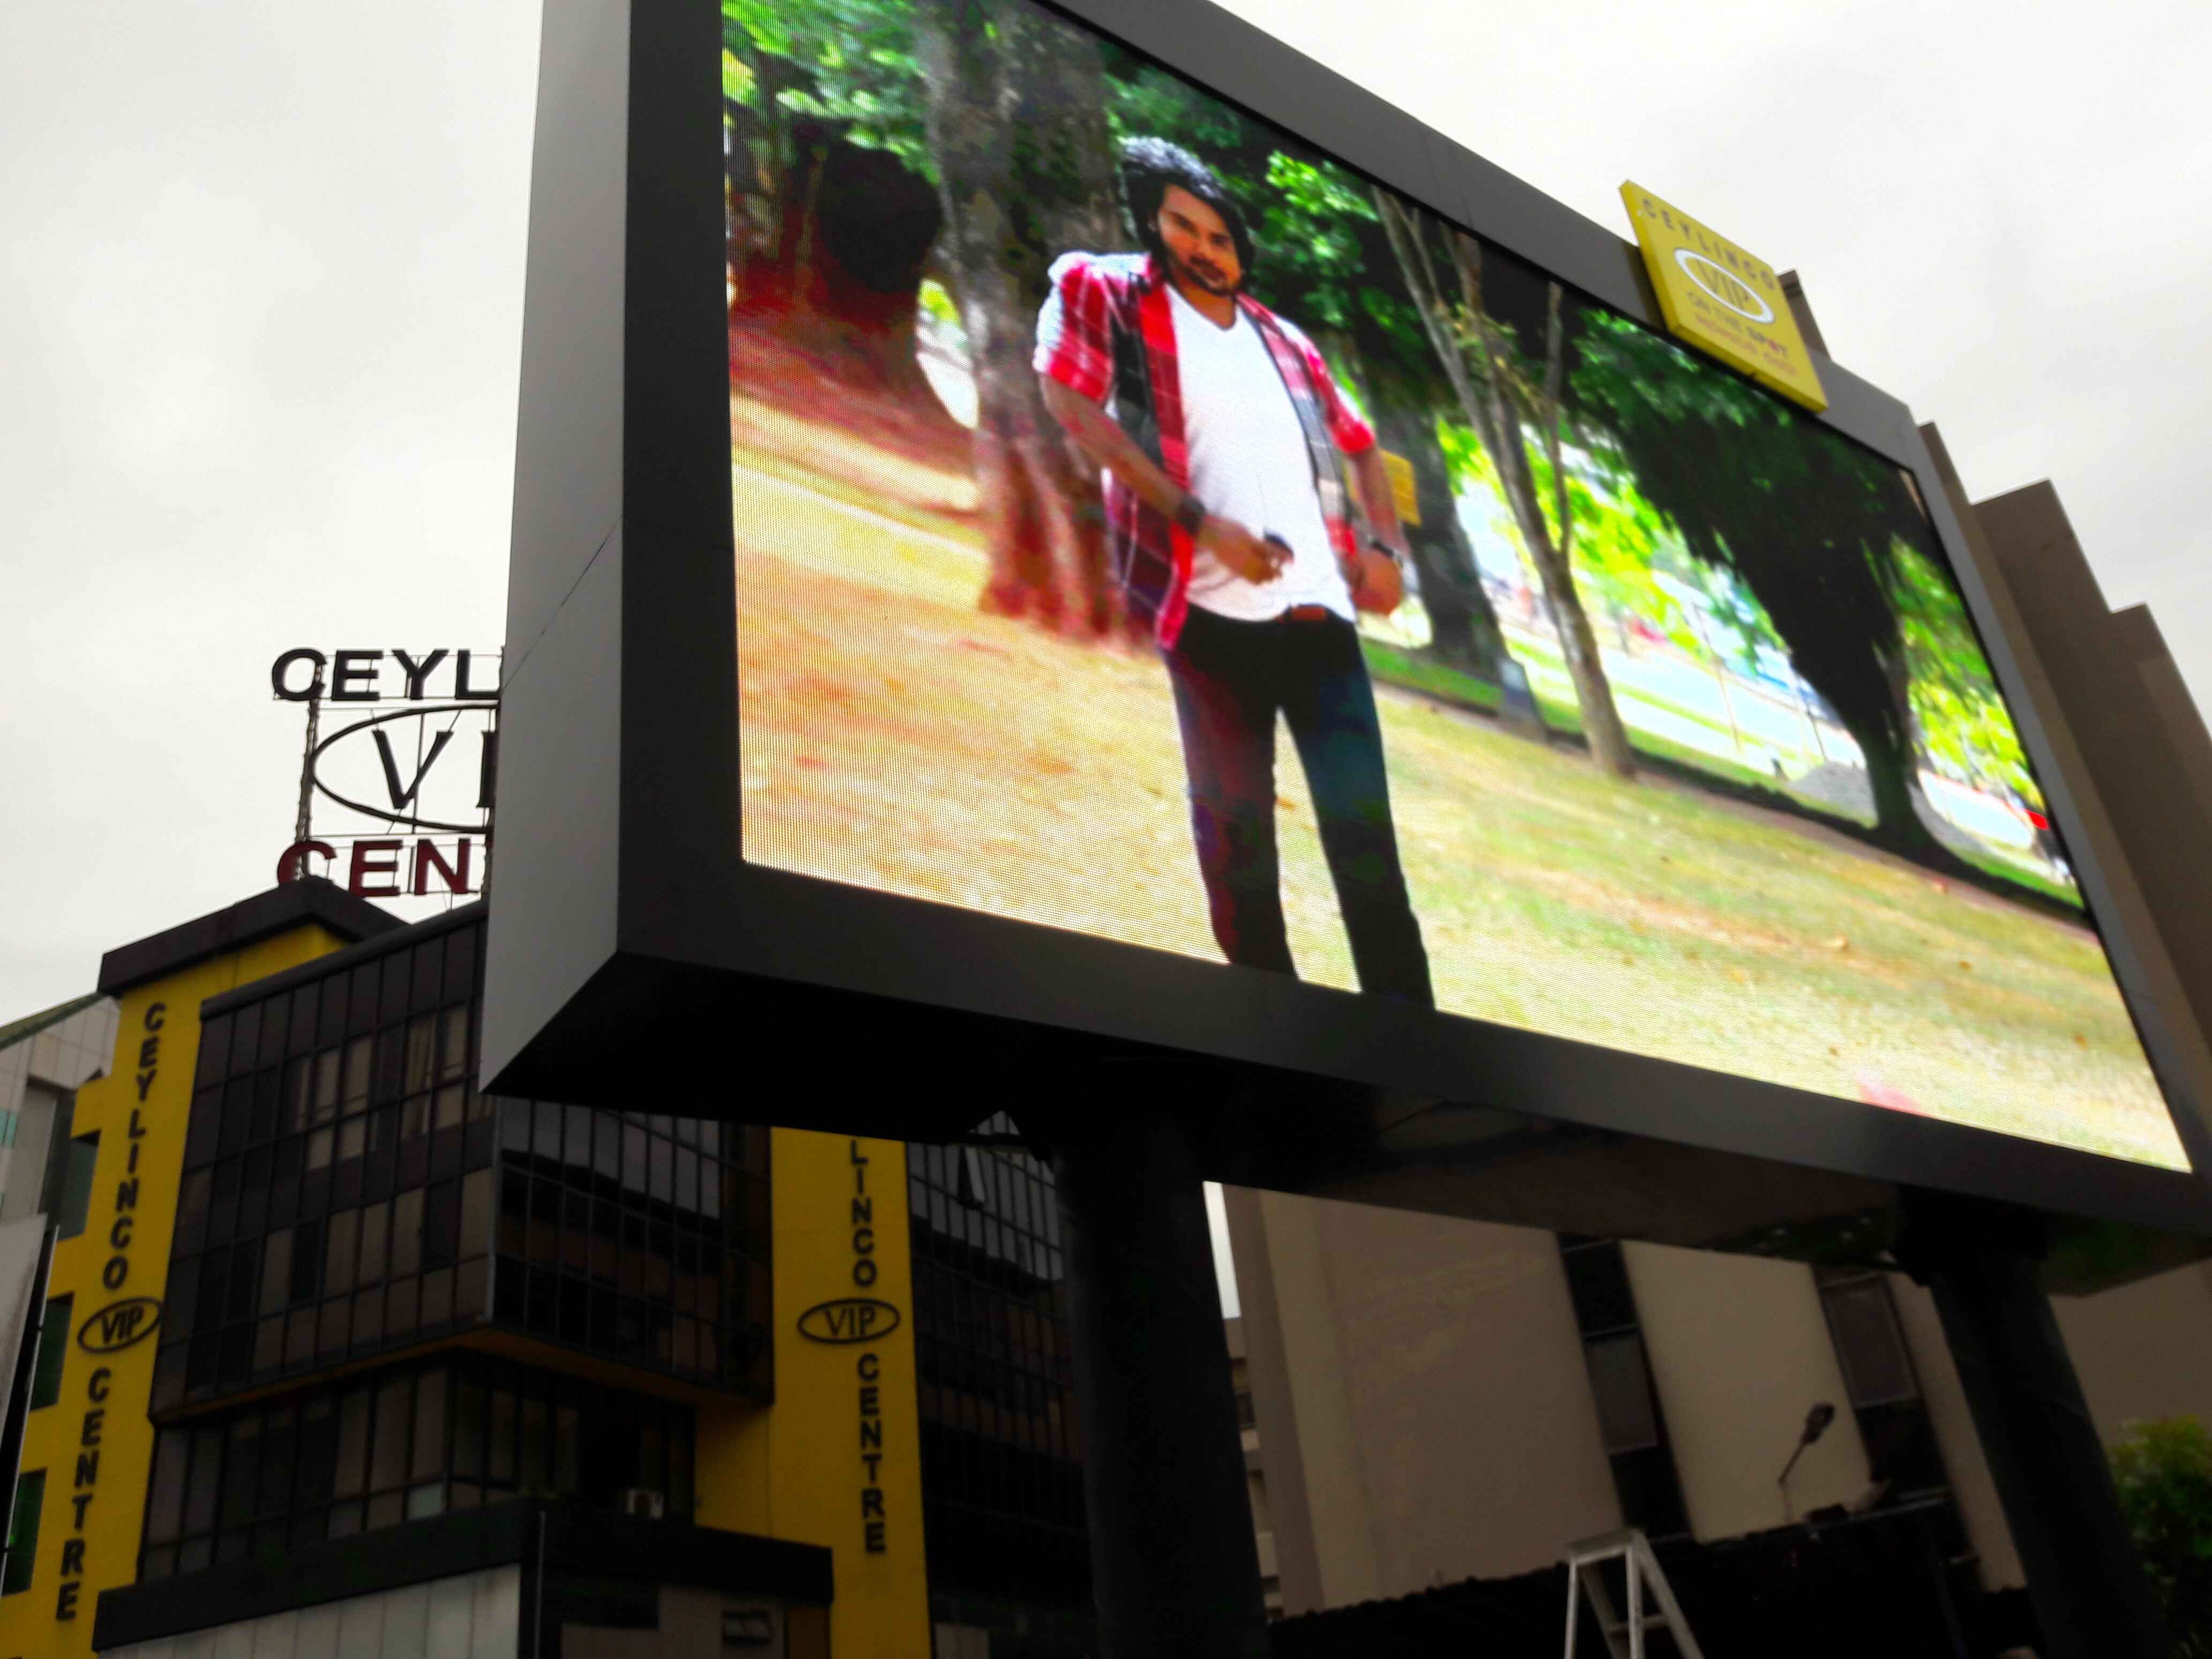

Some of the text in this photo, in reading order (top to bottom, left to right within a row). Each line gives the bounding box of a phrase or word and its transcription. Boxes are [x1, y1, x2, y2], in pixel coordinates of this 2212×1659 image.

[1642, 198, 1775, 290] CEYLINCO
[1696, 259, 1753, 311] VIP
[276, 838, 493, 896] CEN
[55, 1003, 166, 1621] CEYLINCO VIP CENTRE
[825, 1306, 877, 1337] VIP
[857, 1353, 886, 1553] CENTRE
